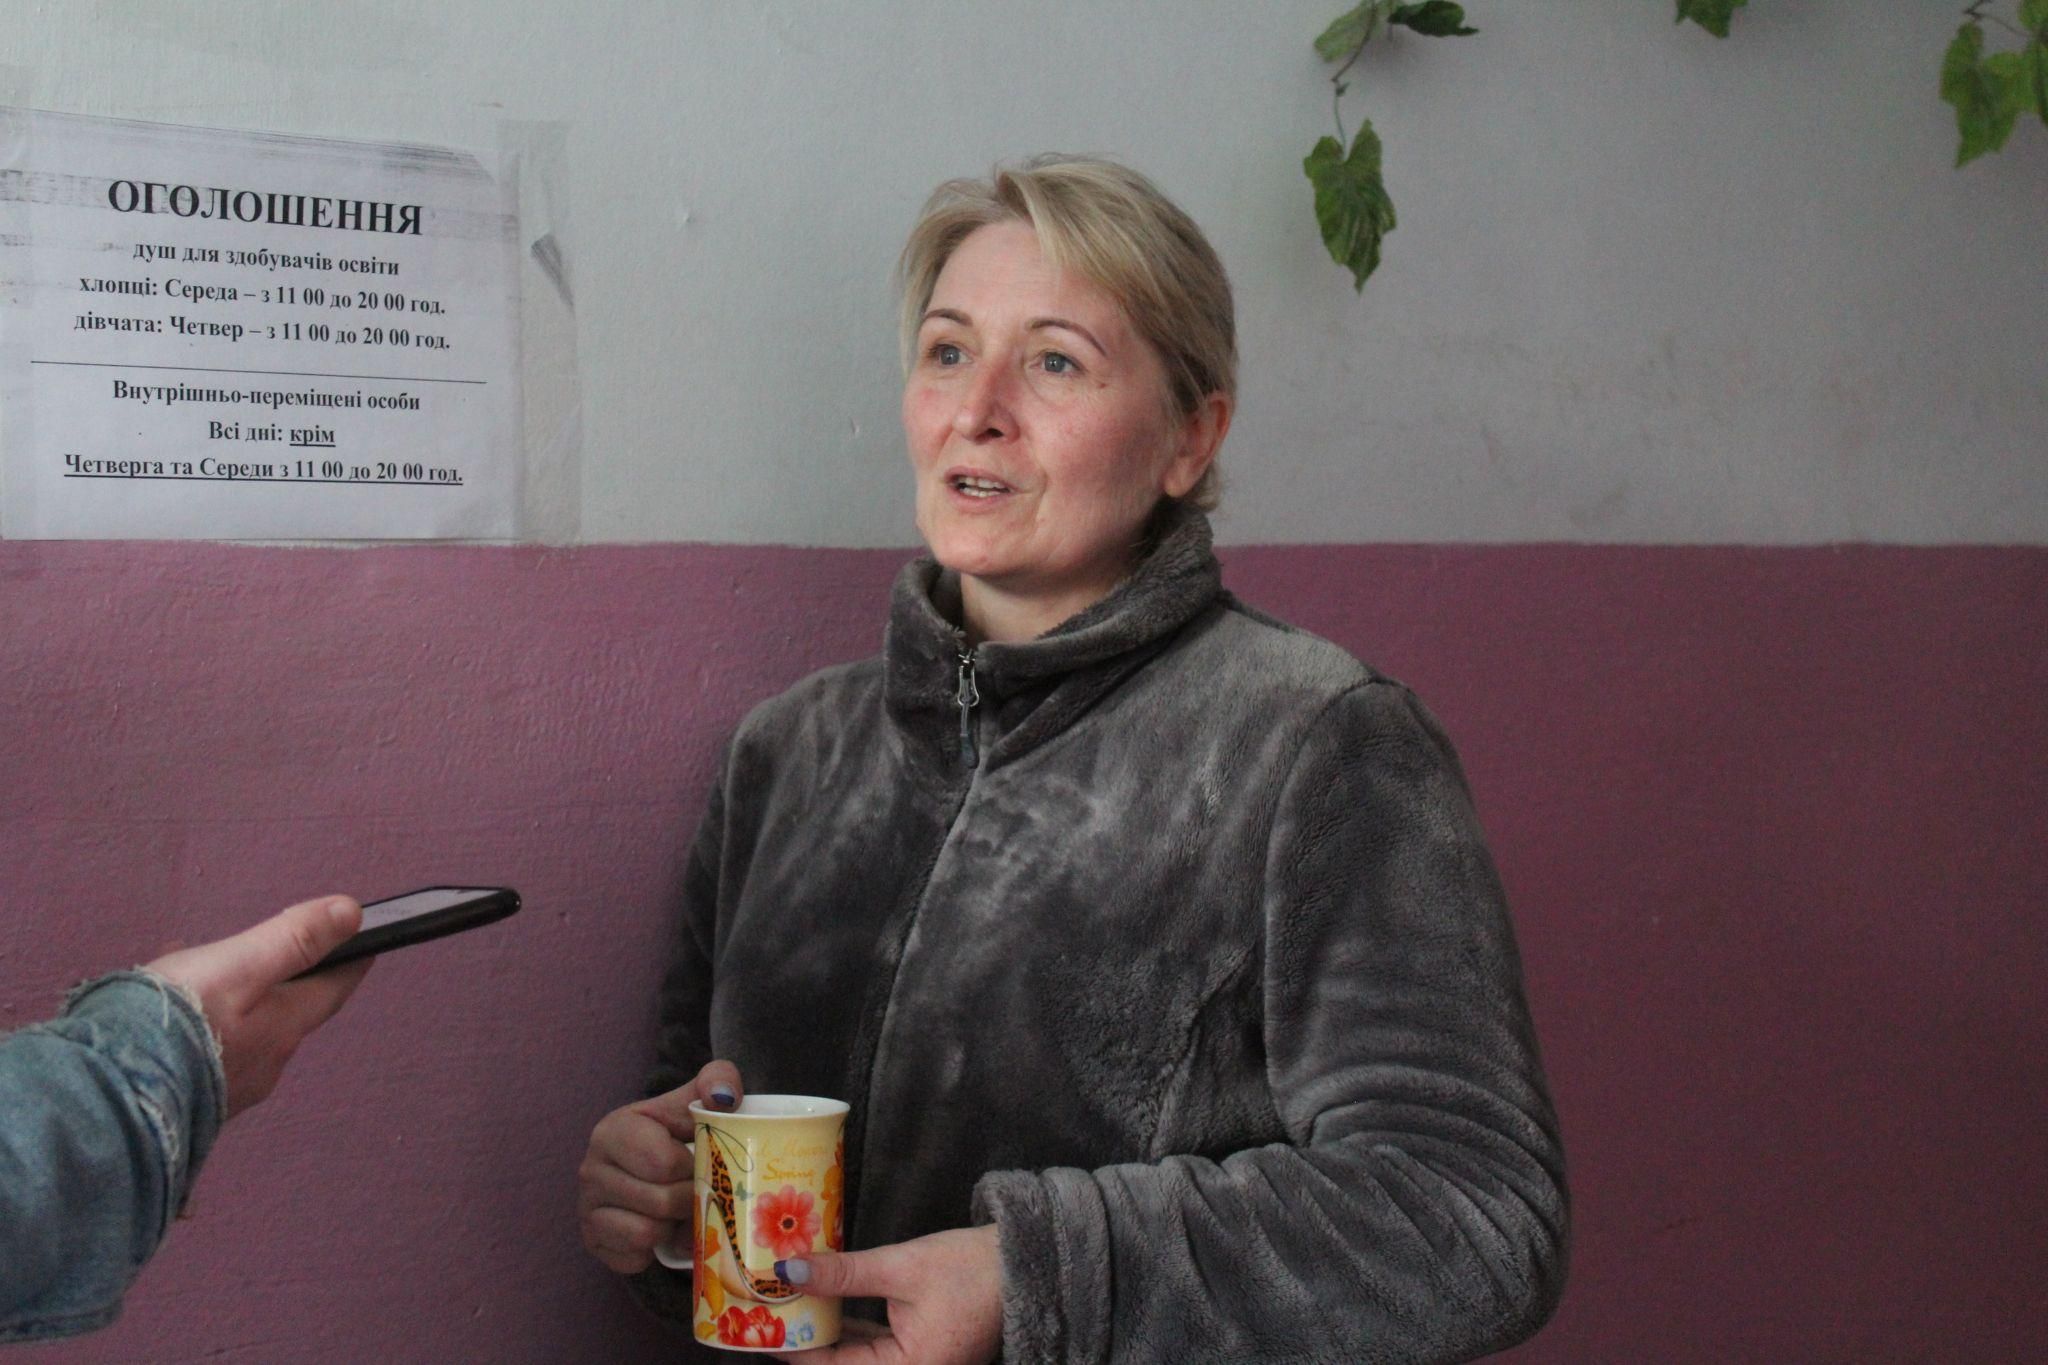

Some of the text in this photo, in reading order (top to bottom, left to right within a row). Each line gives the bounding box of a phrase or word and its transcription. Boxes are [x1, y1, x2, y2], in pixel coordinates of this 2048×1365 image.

[107, 179, 424, 236] ОГОЛОШЕННЯ
[132, 241, 400, 277] душ для здобувачів освіти
[79, 276, 159, 298] хлопці:
[164, 278, 239, 304] Середа
[277, 286, 296, 305] 11
[303, 287, 325, 306] 00
[329, 294, 352, 309] до
[357, 291, 379, 310] 20
[383, 293, 405, 312] 00
[410, 299, 446, 316] год.
[73, 310, 163, 334] дівчата:
[169, 315, 244, 343] Четвер
[283, 322, 301, 341] 11
[308, 323, 330, 343] 00
[335, 330, 358, 345] до
[362, 326, 384, 346] 20
[388, 328, 410, 347] 00
[415, 335, 451, 350] год.
[112, 379, 421, 411] Внутрішньо-переміщені особи
[209, 420, 336, 447] Всі дні: крім
[64, 453, 164, 478] Четверга
[169, 461, 194, 476] та
[199, 457, 274, 481] Середи
[295, 460, 314, 479] 11
[321, 460, 344, 479] 00
[348, 466, 371, 481] до
[376, 462, 398, 481] 20
[402, 462, 424, 482] 00
[428, 468, 465, 485] год.
